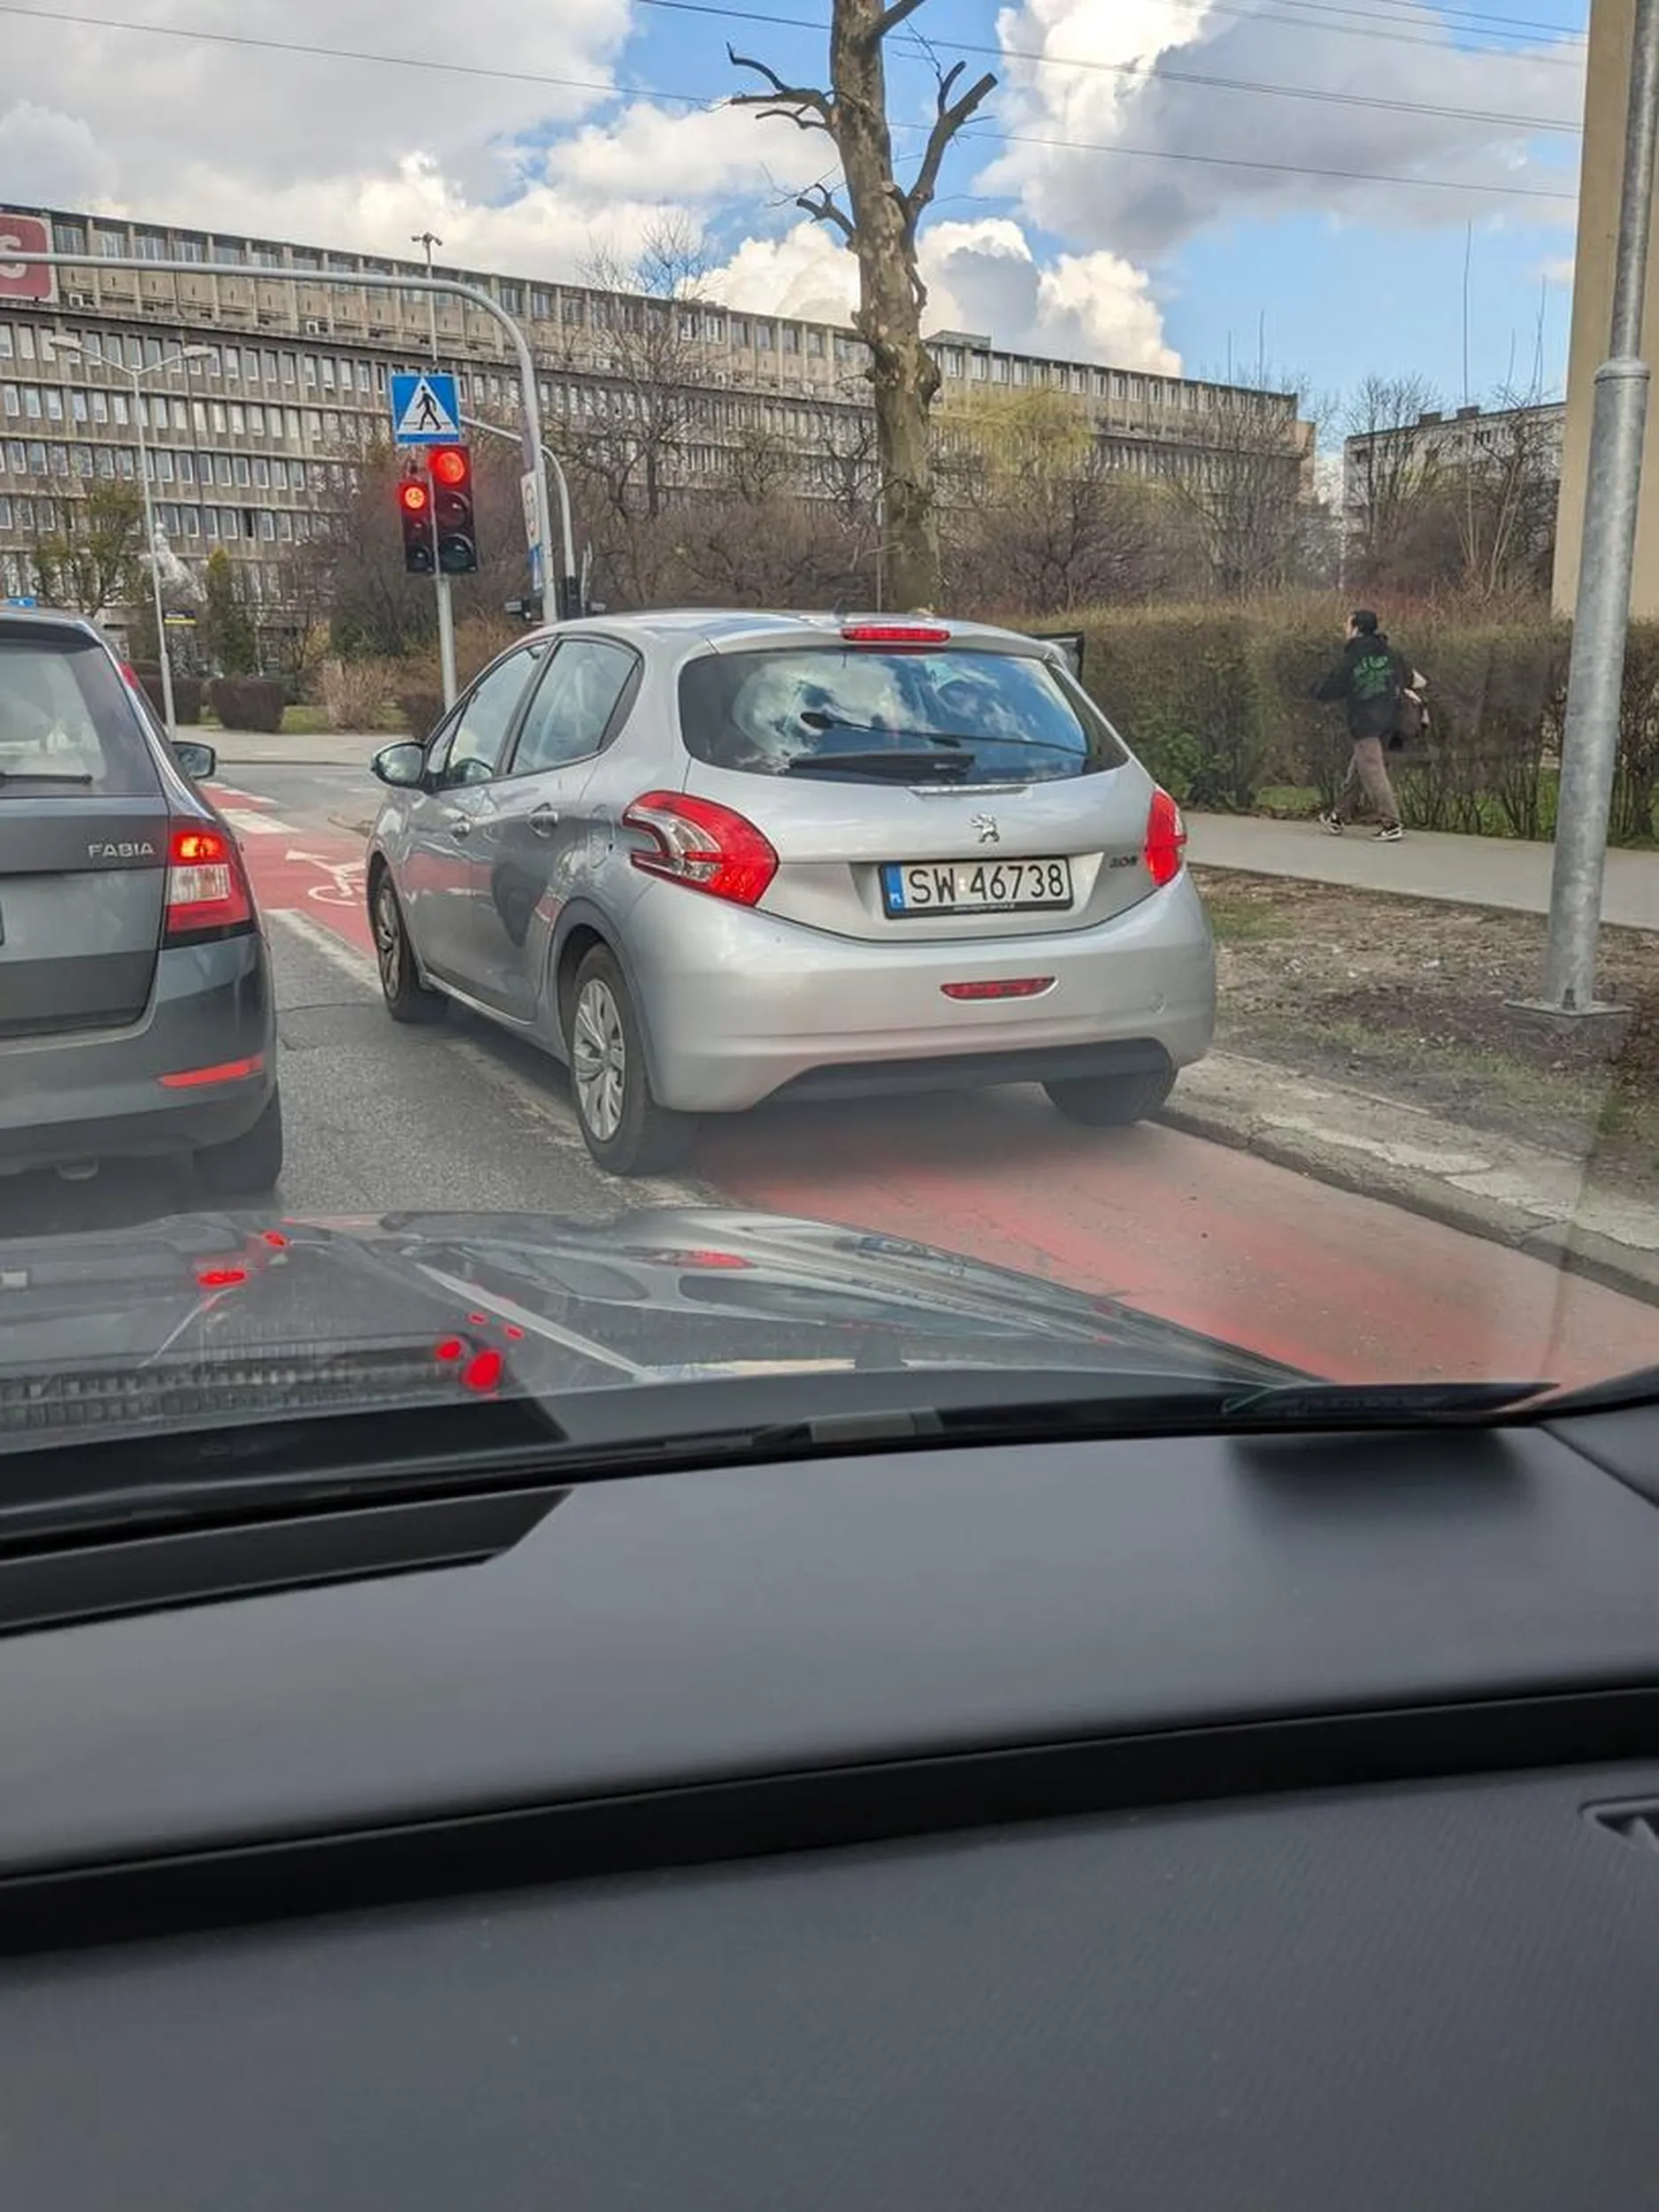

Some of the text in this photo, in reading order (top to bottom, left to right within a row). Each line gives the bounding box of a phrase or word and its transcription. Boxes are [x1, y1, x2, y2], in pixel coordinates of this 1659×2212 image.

[88, 842, 155, 858] FABIA
[908, 864, 1064, 903] SW 46738
